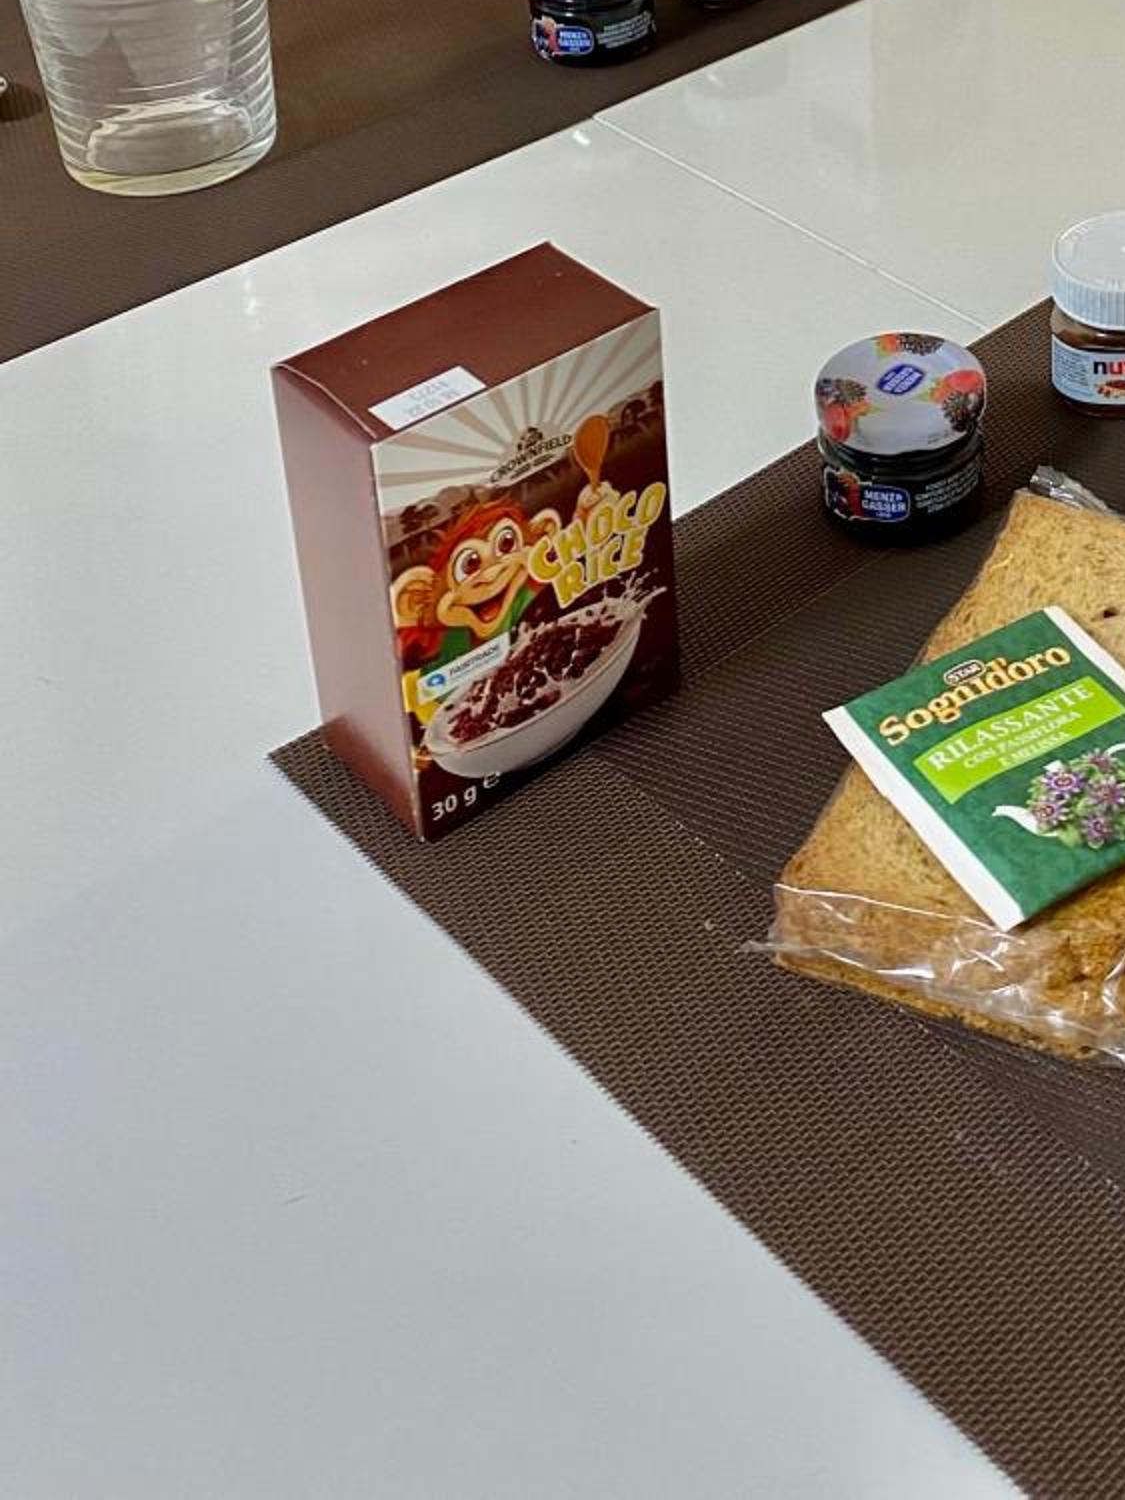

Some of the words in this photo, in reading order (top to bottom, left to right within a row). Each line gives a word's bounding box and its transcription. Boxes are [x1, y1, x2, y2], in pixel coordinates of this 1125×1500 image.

[490, 434, 572, 483] CROWNFIELD
[528, 482, 666, 582] CHOCO
[551, 527, 648, 608] RICE
[926, 683, 1094, 771] RILASSANTE
[431, 794, 458, 821] 30
[463, 785, 477, 807] g
